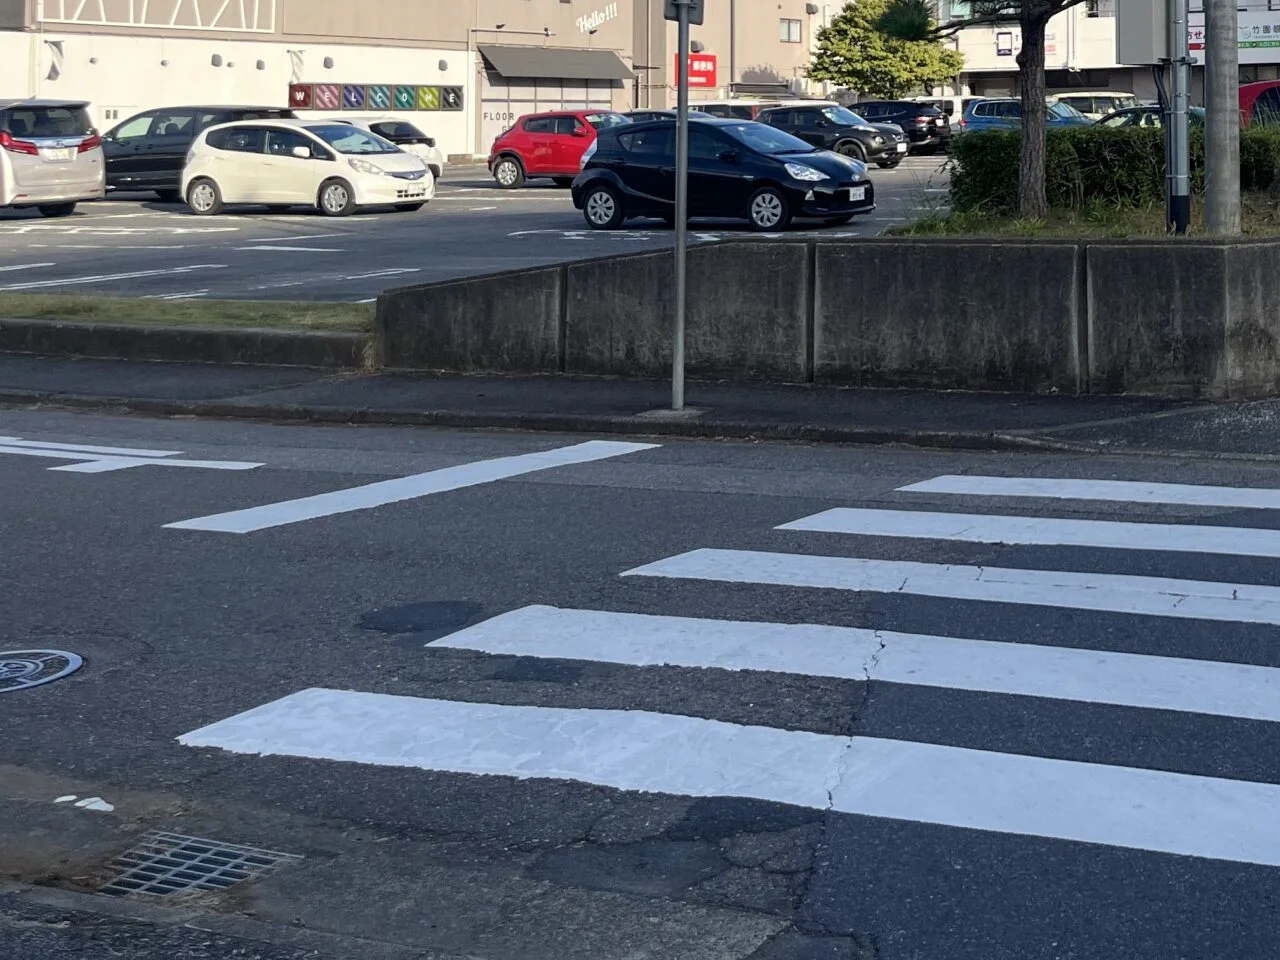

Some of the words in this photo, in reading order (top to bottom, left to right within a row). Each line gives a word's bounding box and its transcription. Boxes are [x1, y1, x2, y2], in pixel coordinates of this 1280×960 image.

[575, 1, 618, 33] Hello!!!
[294, 91, 456, 104] WELCOME
[483, 112, 515, 121] FLOOR
